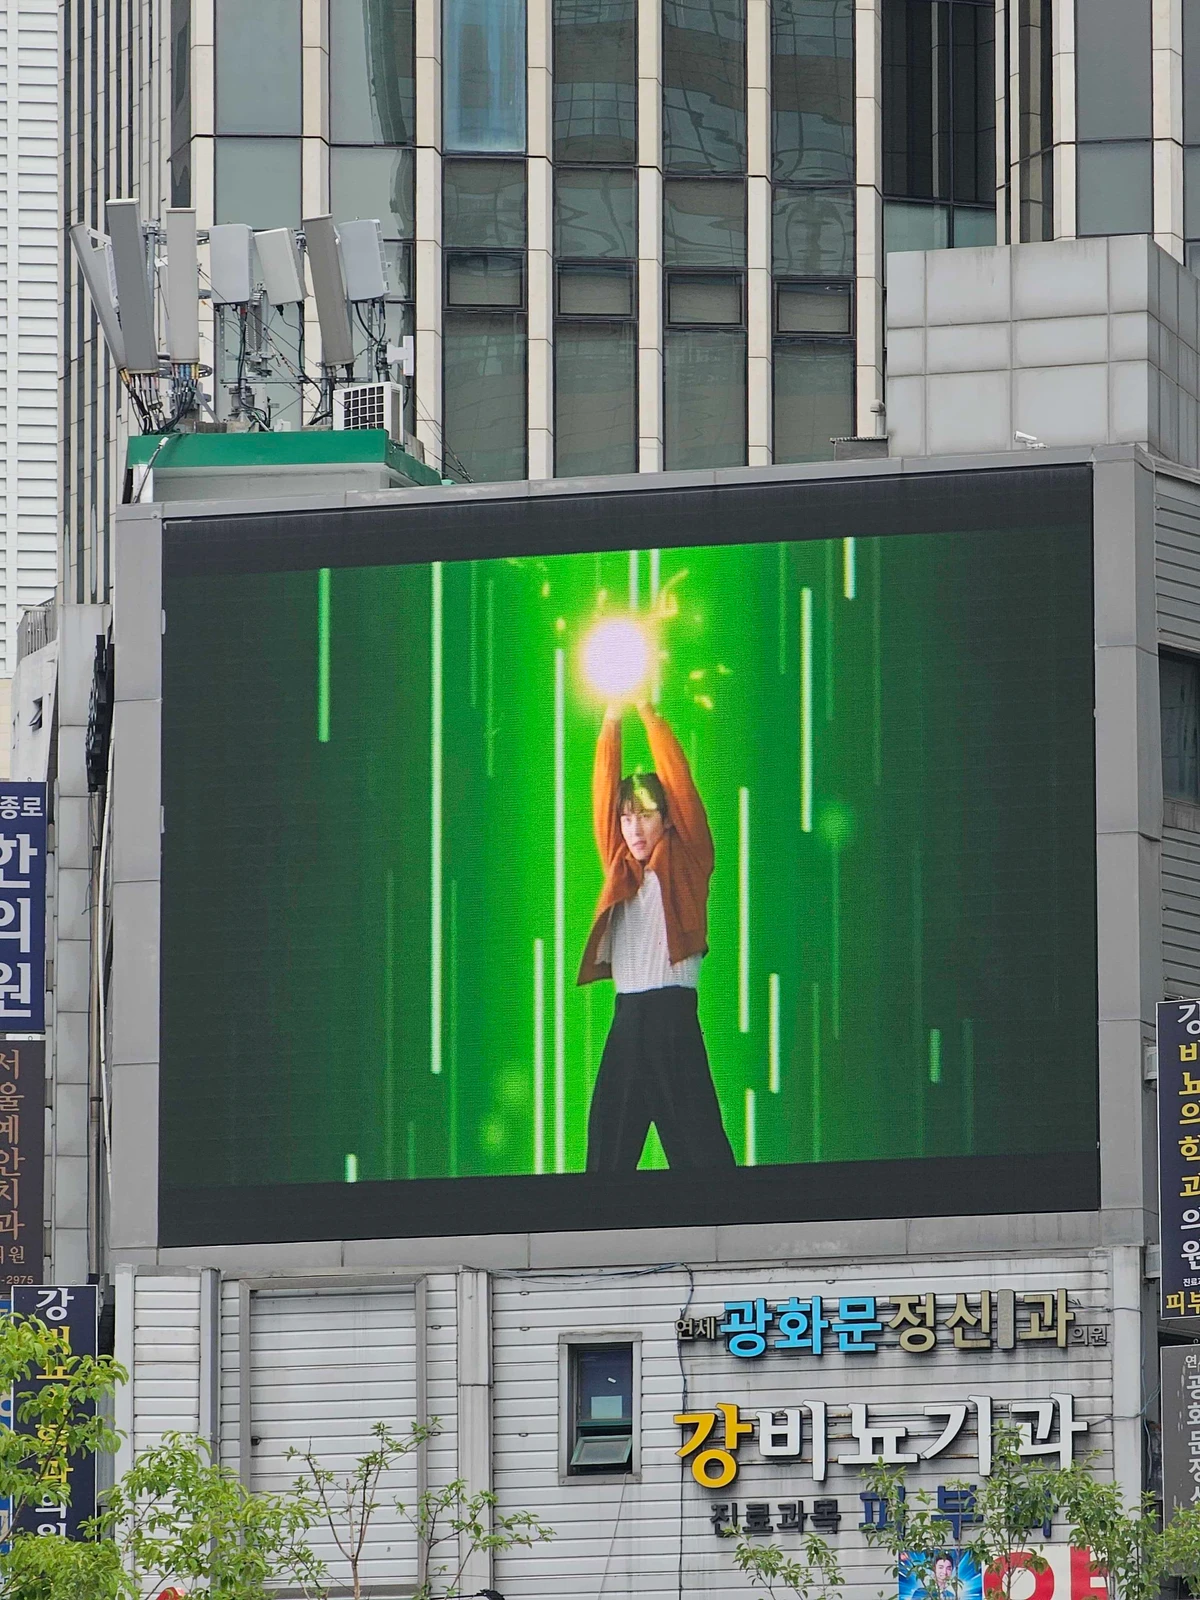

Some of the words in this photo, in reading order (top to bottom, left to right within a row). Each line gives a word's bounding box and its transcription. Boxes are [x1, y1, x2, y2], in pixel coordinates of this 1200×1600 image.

[675, 1316, 717, 1341] 연세
[1071, 1325, 1109, 1347] 의원
[673, 1392, 1090, 1489] 강비뇨기과
[710, 1499, 842, 1538] 진료과목
